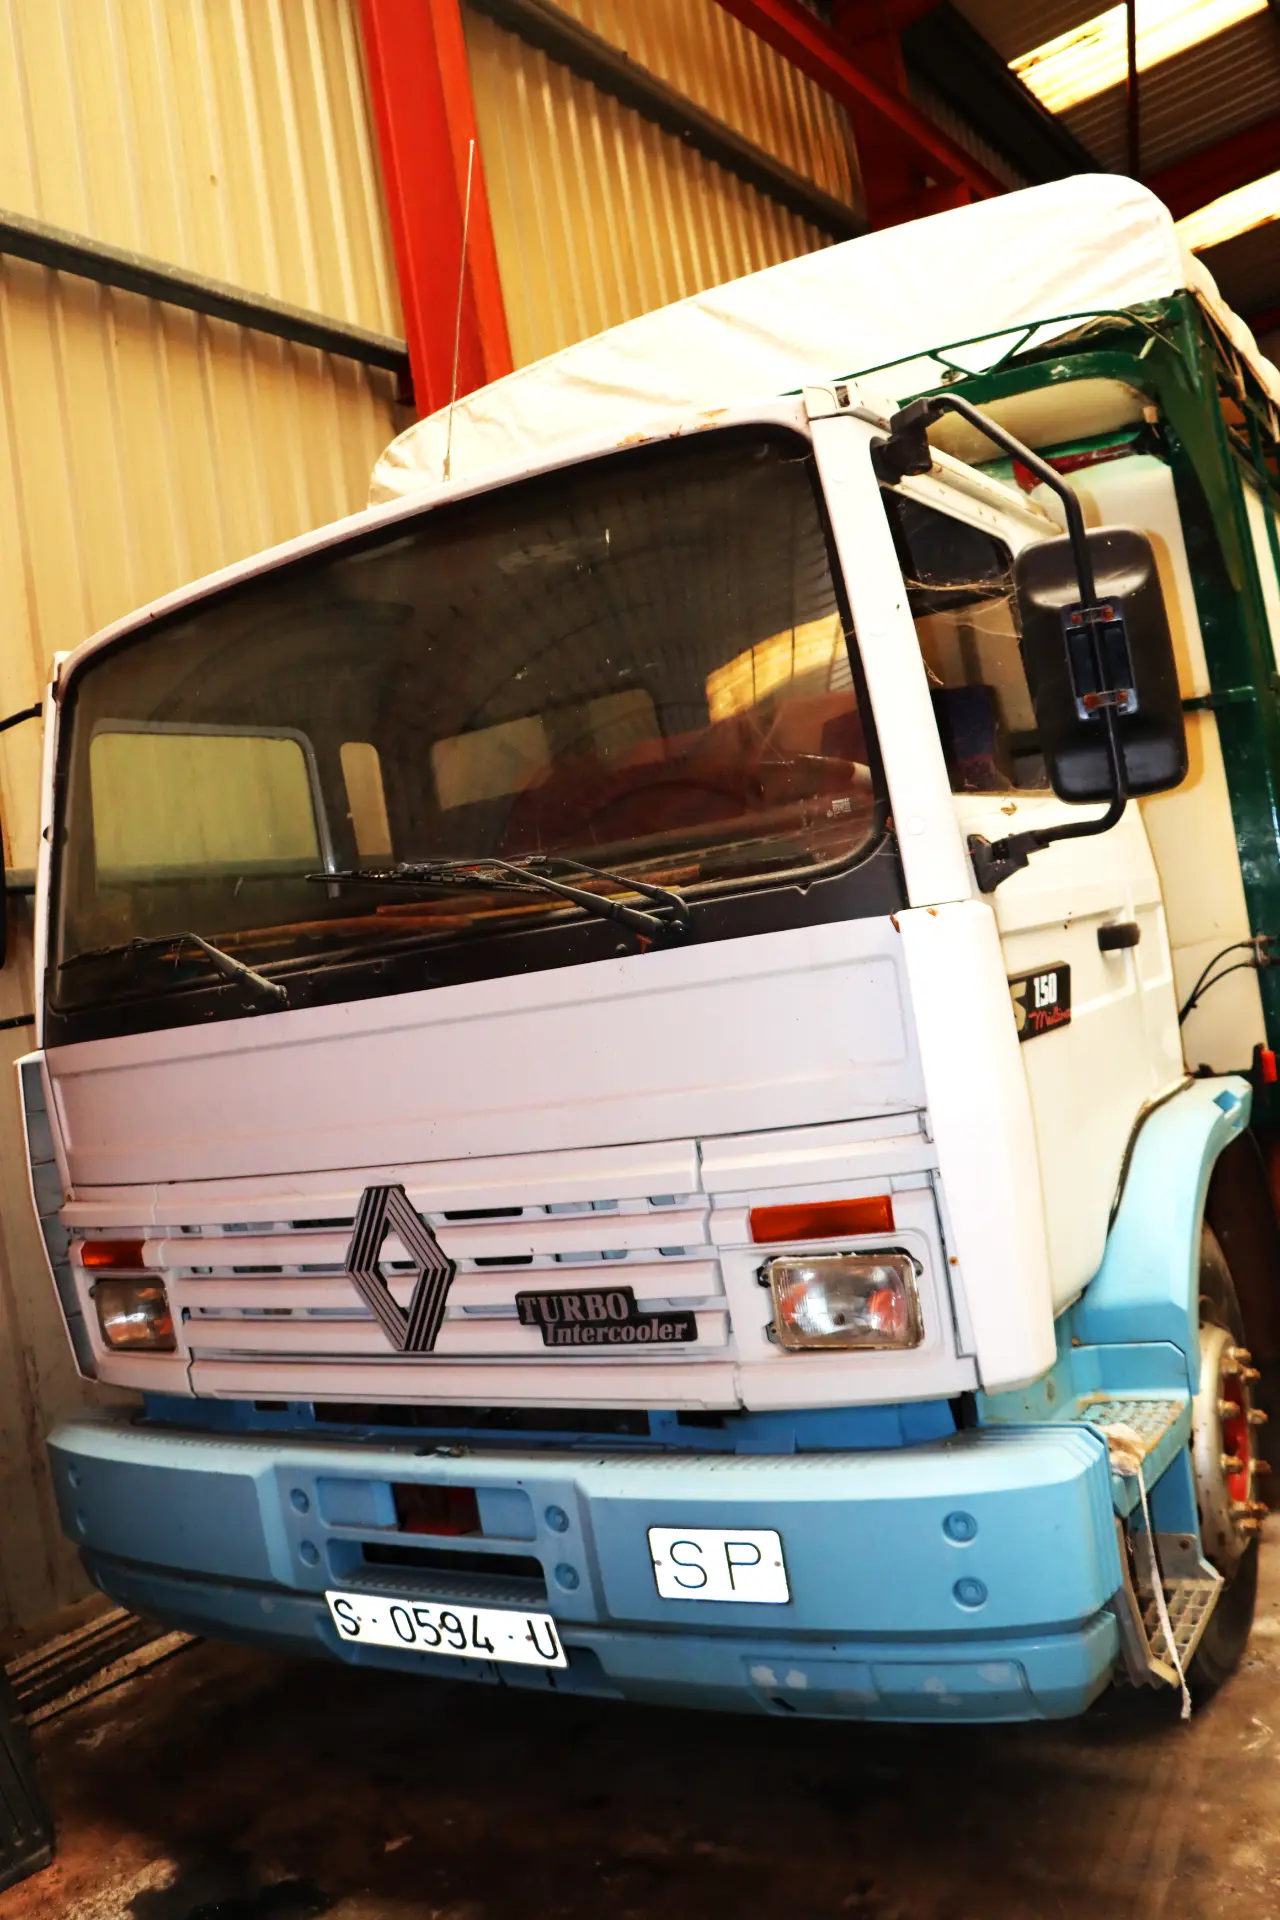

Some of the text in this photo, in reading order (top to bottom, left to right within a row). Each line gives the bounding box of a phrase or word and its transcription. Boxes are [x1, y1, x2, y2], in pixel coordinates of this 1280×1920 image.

[1033, 972, 1058, 1008] 150
[518, 1292, 629, 1323] TURBO
[546, 1318, 688, 1345] Intercooler
